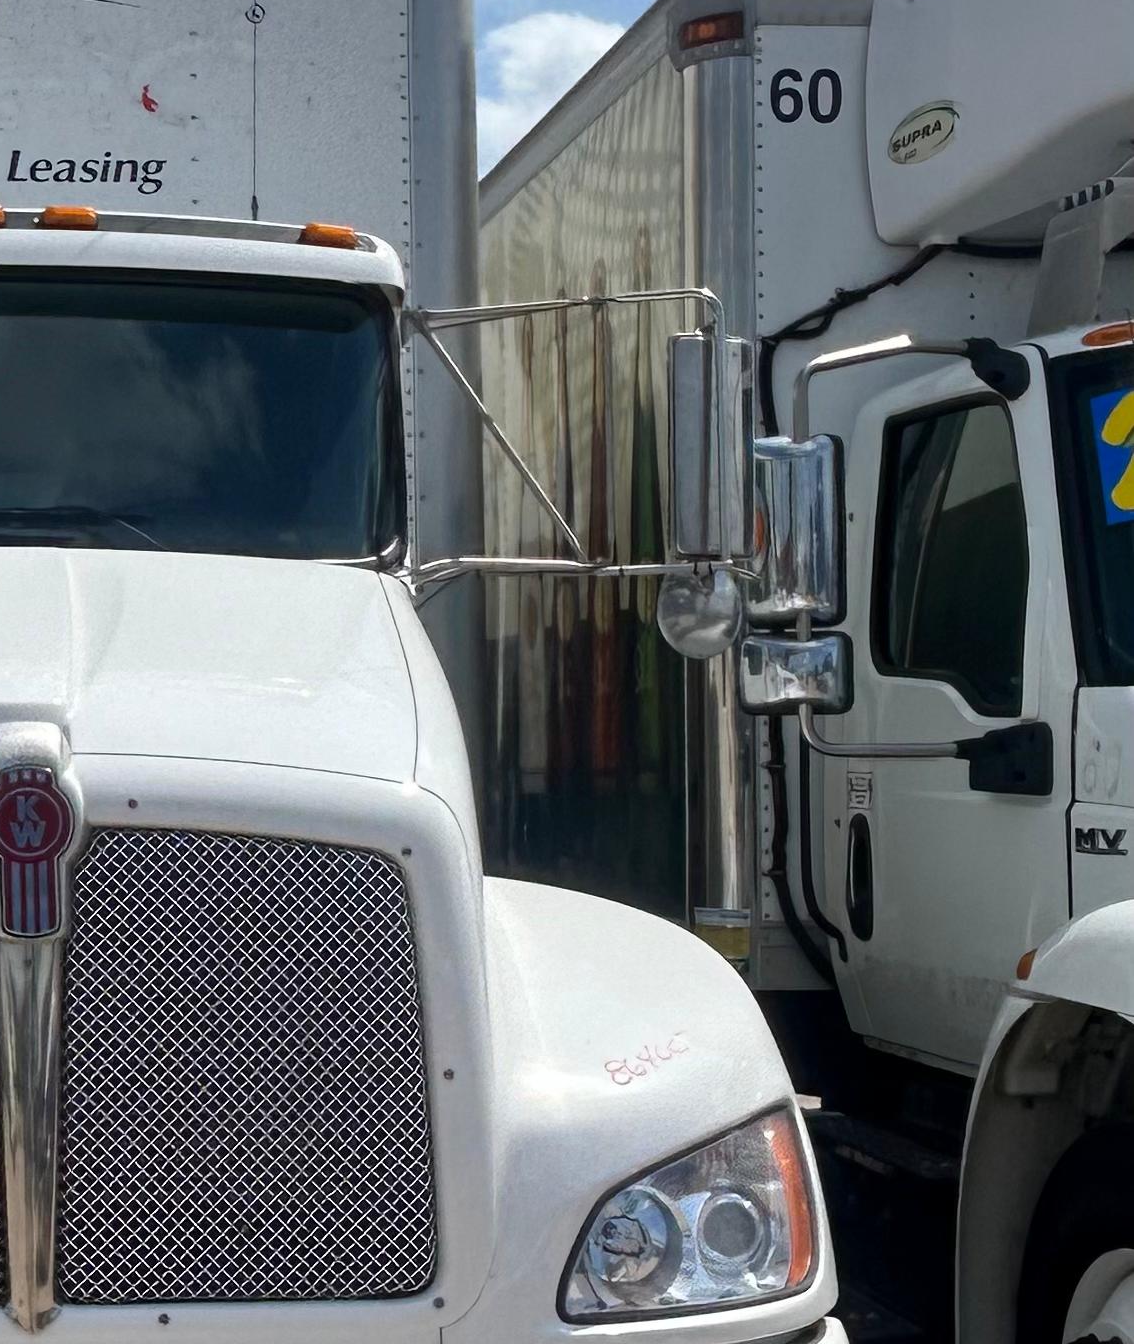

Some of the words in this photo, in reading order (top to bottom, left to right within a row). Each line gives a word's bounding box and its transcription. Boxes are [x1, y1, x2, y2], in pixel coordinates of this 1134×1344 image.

[770, 68, 842, 124] 60
[891, 119, 943, 154] SUPRA
[7, 150, 167, 195] Leasing
